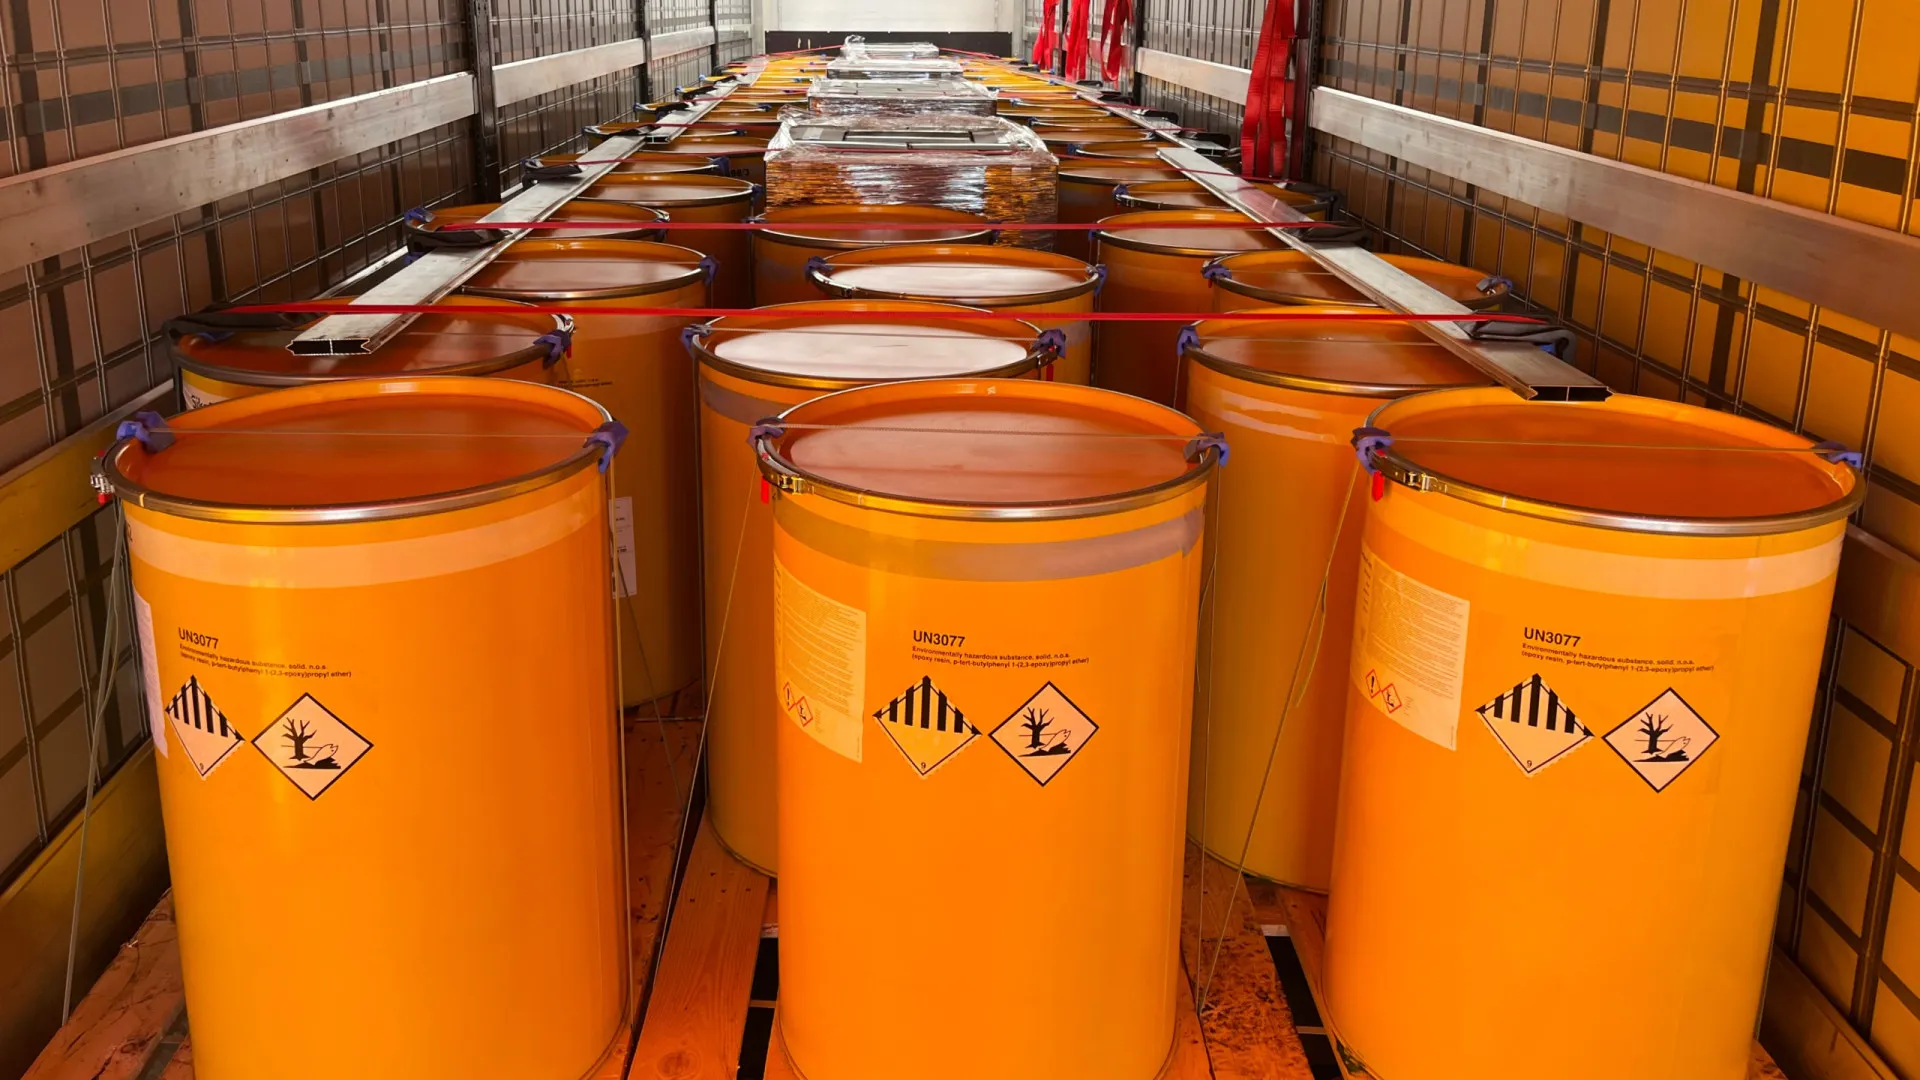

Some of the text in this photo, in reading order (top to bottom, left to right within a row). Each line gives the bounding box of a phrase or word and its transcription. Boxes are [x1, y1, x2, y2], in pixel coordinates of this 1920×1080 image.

[178, 627, 219, 649] UN3077
[913, 630, 966, 648] UN3077
[1523, 627, 1581, 647] UN3077
[912, 645, 962, 659] Environmentally
[964, 652, 998, 660] hazardous
[1521, 650, 1543, 661] (epoxy
[1522, 643, 1577, 658] Environmentally
[1579, 652, 1615, 663] hazardous
[912, 653, 932, 663] (epoxy
[953, 659, 1010, 669] p-tert-butylphenyl
[920, 761, 927, 771] 9
[1526, 759, 1533, 769] 9
